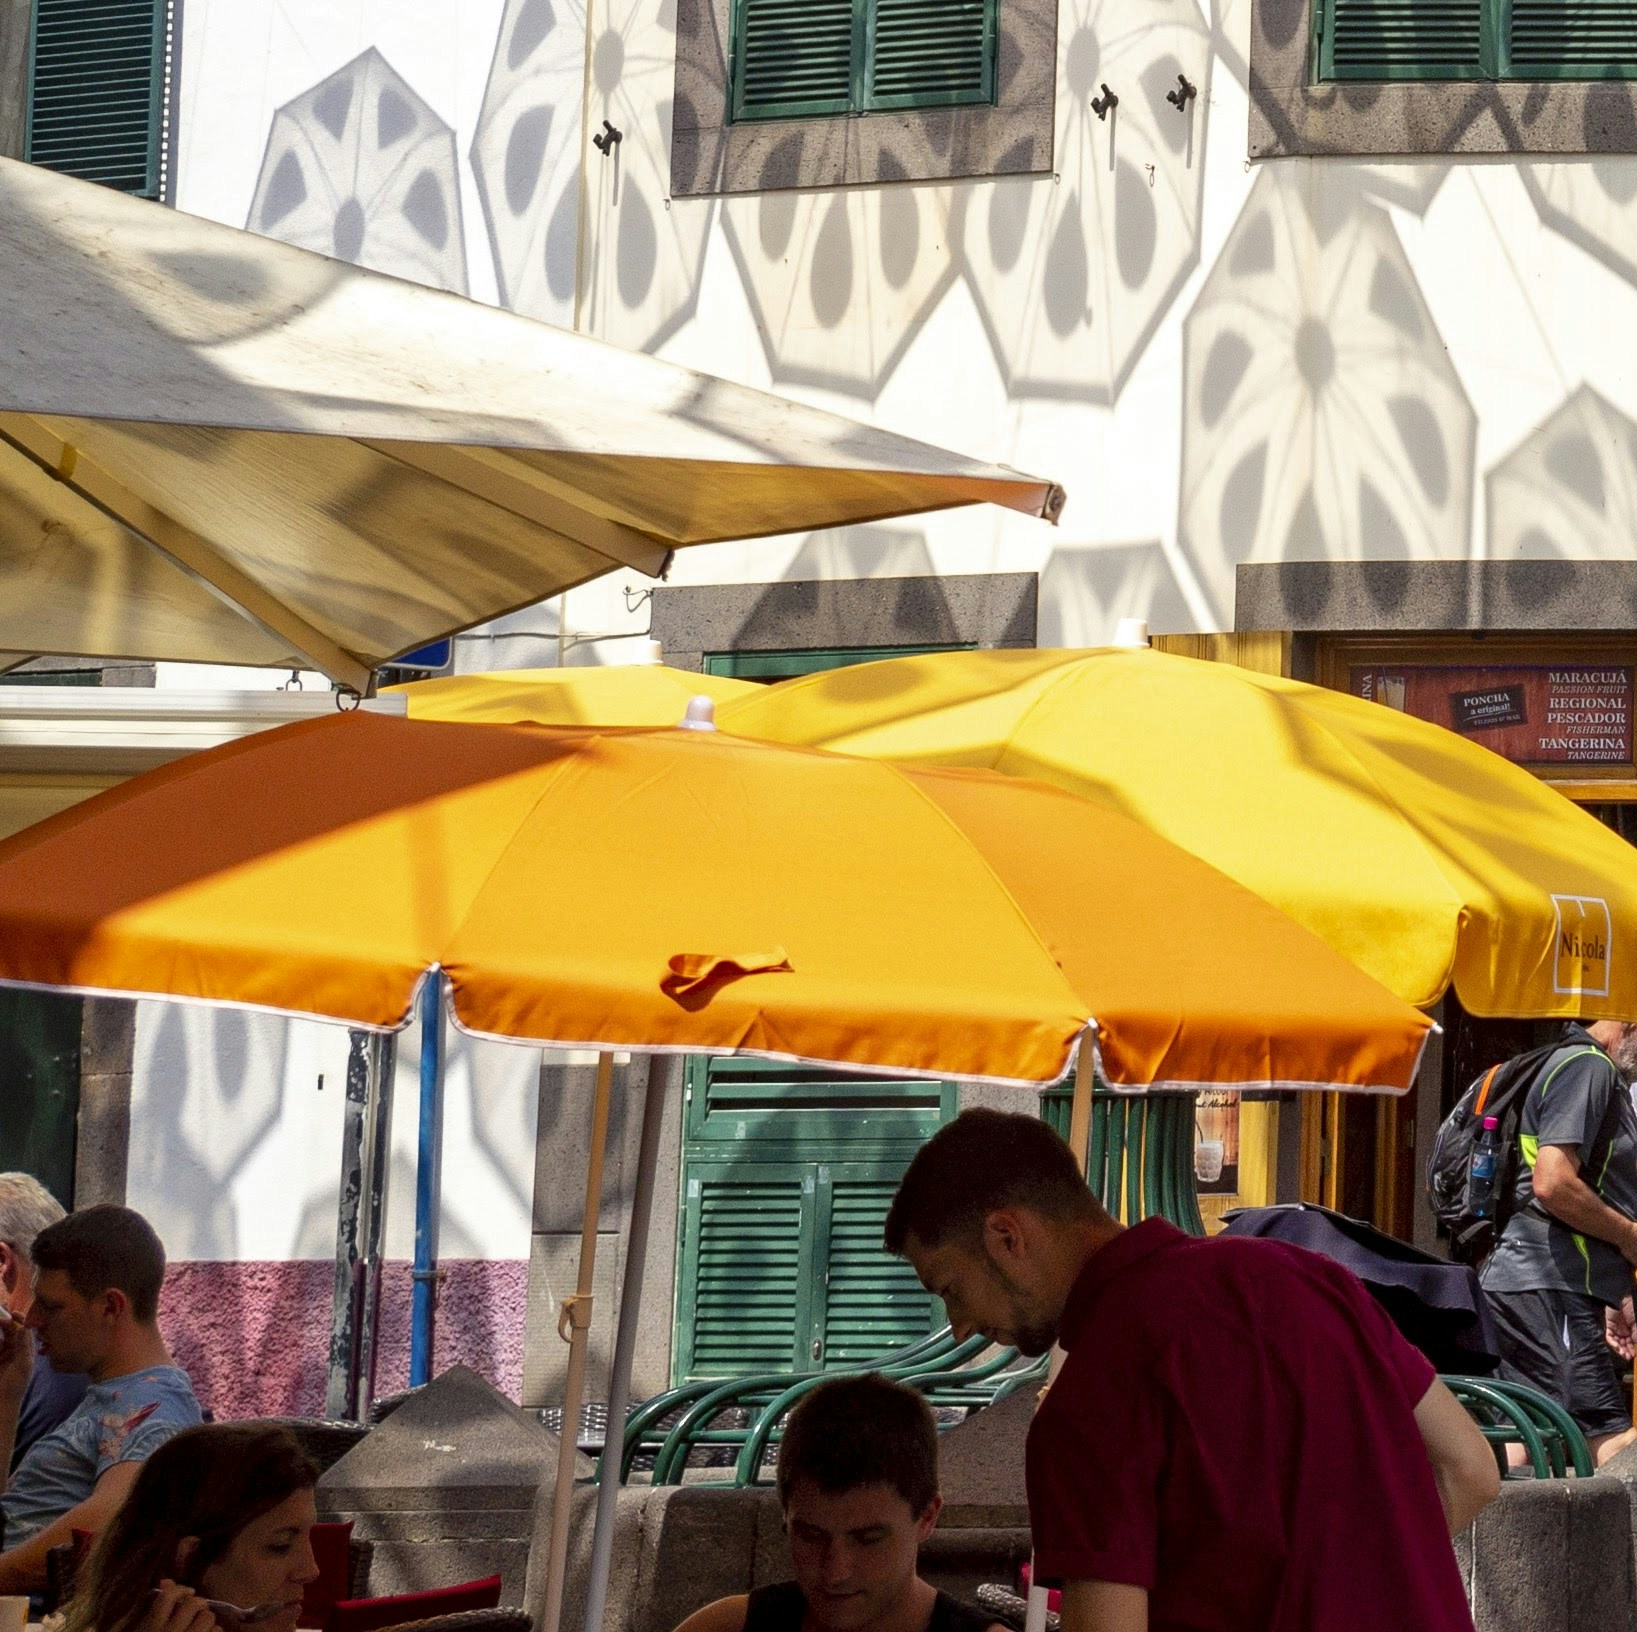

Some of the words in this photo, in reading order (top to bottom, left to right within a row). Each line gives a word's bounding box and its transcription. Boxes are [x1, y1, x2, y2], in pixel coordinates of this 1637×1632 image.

[1548, 669, 1627, 684] MARACUJÁ
[1551, 685, 1595, 694] PASSION
[1596, 685, 1628, 694] FRUIT
[1463, 692, 1510, 707] PONCHA
[1550, 697, 1627, 709] REGIONAL
[1547, 712, 1626, 724] PESCADOR
[1566, 726, 1626, 734] FISHERMAN
[1538, 737, 1626, 750] TANGERINA
[1566, 751, 1625, 760] TANGERINE
[1561, 932, 1606, 960] Nicola
